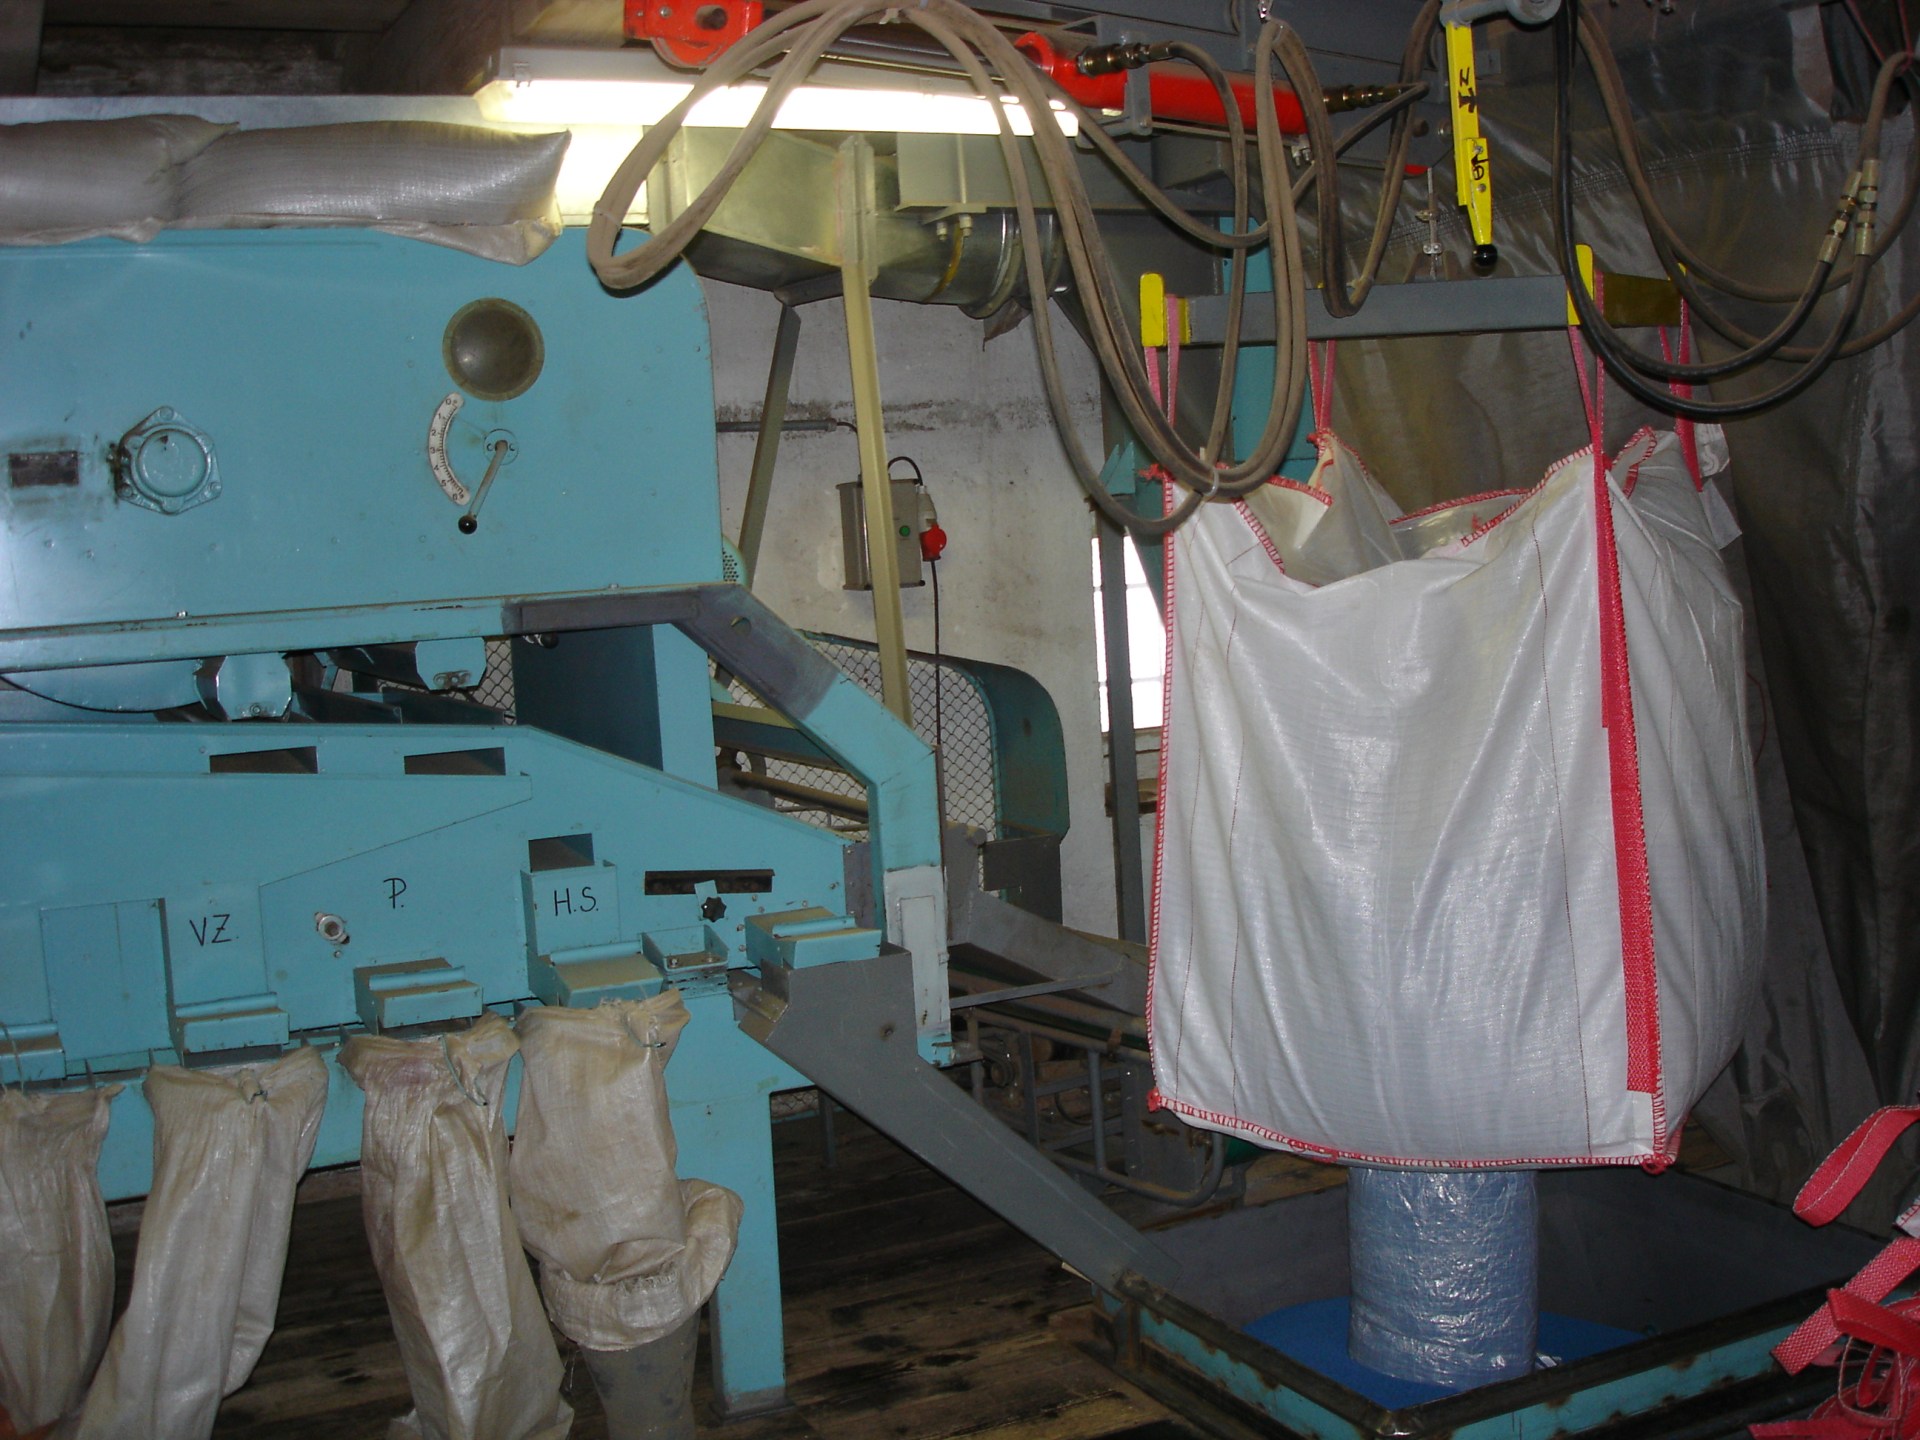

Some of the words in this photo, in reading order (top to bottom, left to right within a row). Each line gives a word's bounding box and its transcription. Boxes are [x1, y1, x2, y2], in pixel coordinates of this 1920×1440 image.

[429, 446, 436, 455] 3
[440, 479, 447, 487] 5
[554, 886, 599, 916] H.S.
